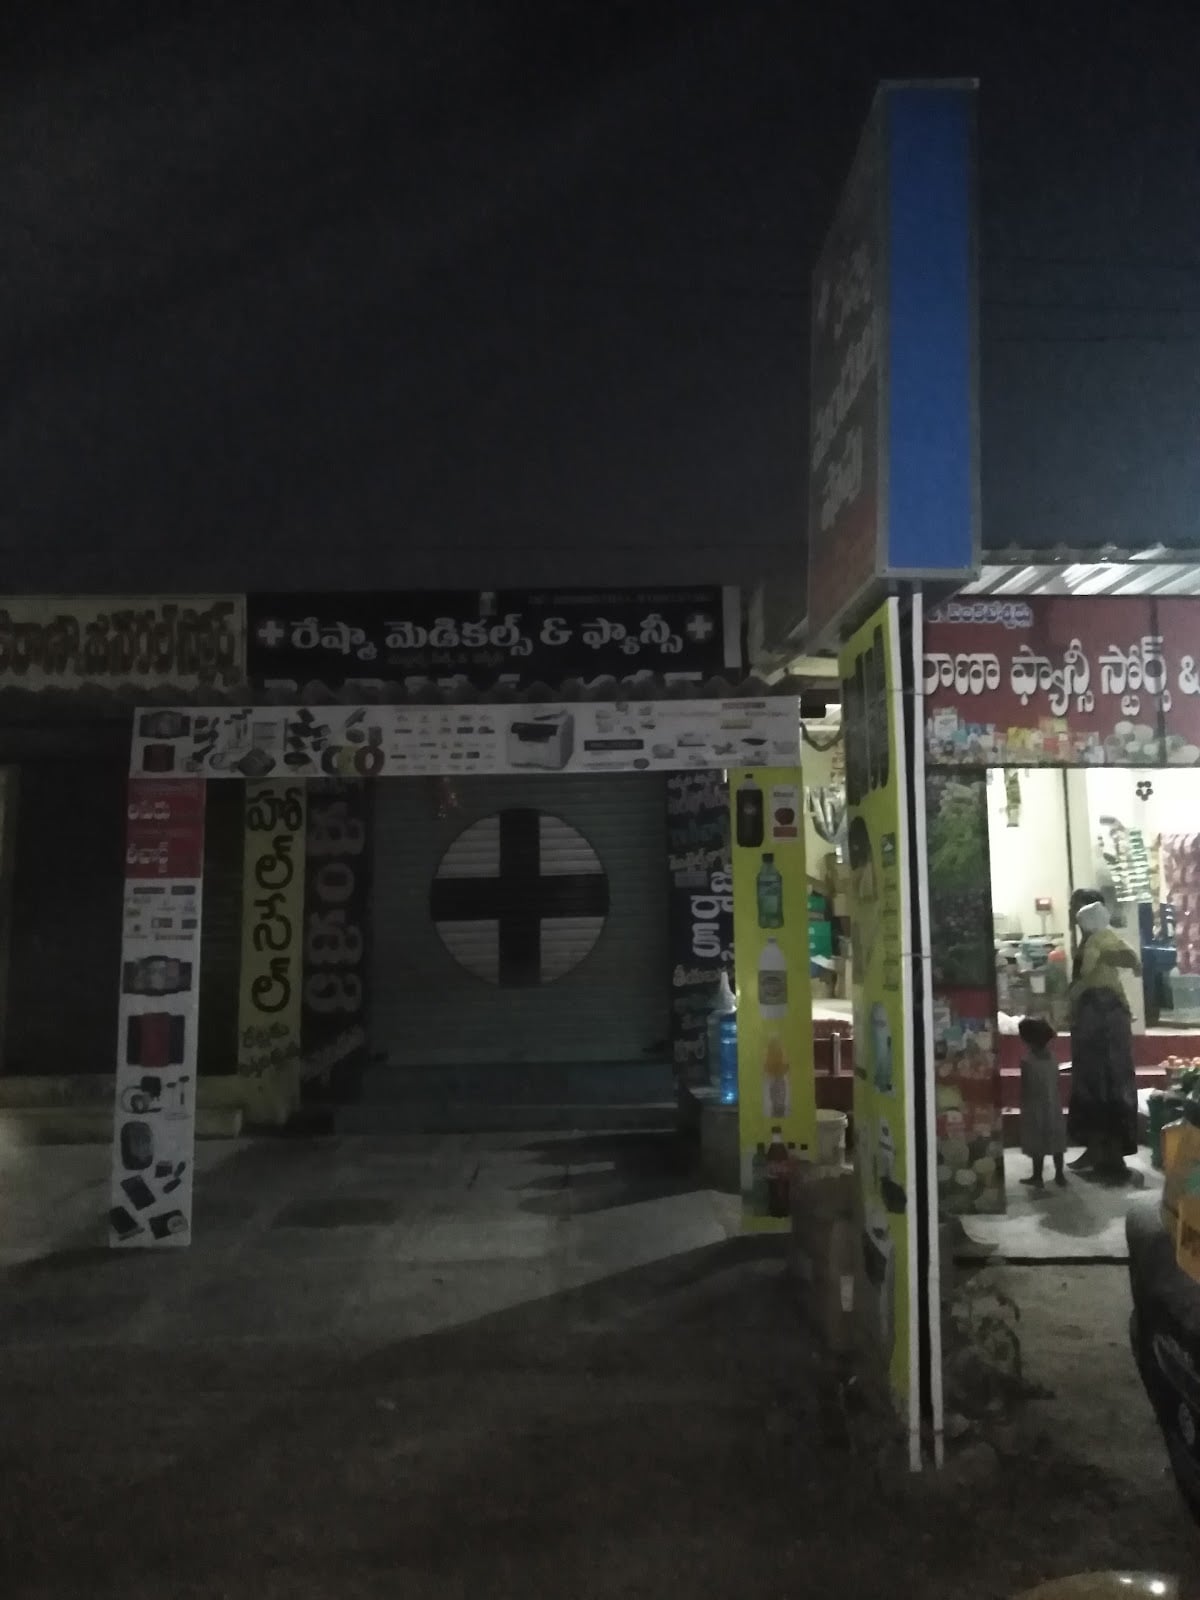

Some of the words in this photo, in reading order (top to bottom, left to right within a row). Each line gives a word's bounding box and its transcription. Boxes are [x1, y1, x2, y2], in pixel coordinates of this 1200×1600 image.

[290, 616, 378, 660] రేష్మా
[384, 612, 533, 656] మెడికల్స్
[540, 617, 572, 647] &
[582, 612, 684, 655] ఫ్యాన్సీ
[1010, 637, 1095, 716] ఫ్యాన్సీ
[1098, 635, 1172, 717] స్టోర్స్
